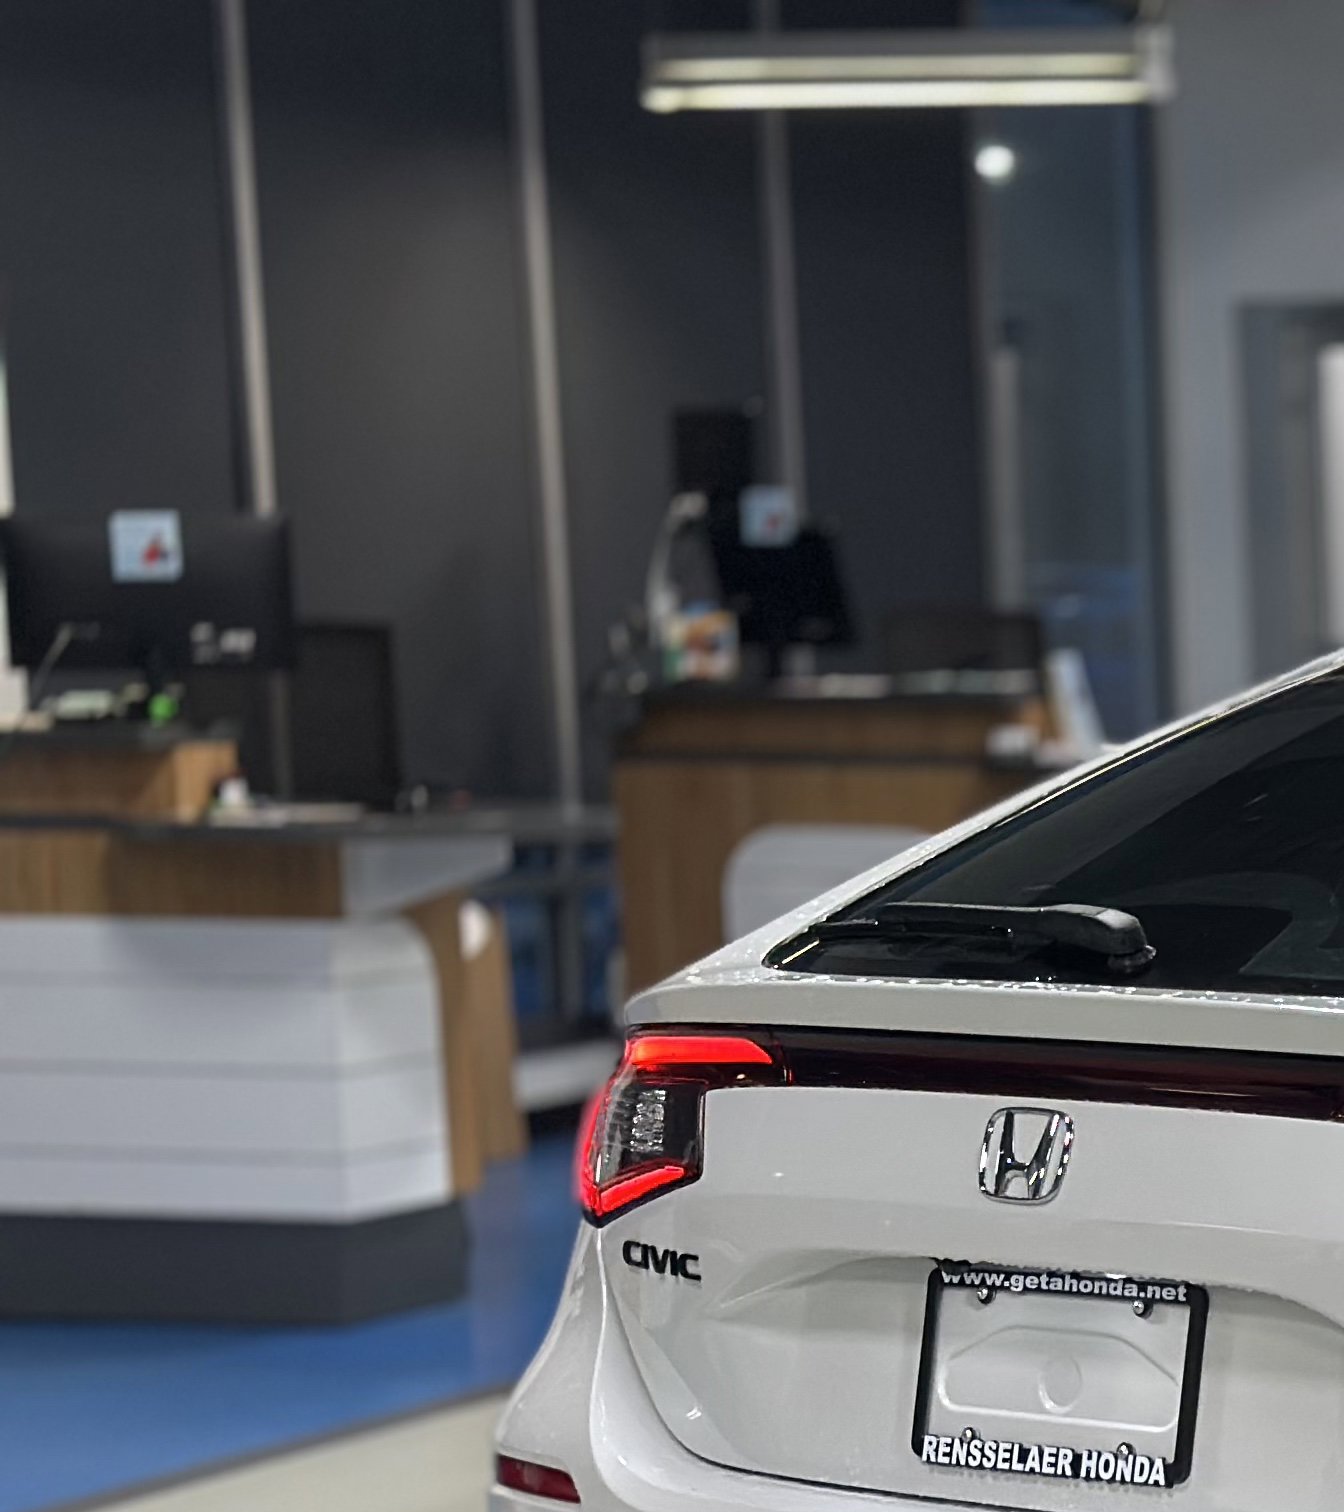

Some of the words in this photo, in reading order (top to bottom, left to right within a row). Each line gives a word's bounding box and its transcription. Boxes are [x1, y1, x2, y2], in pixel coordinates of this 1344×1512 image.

[622, 1240, 702, 1281] CIVIC
[941, 1270, 1187, 1301] www.getahonda.net
[921, 1434, 1073, 1476] RENSSELAER
[1080, 1449, 1167, 1486] HONDA
